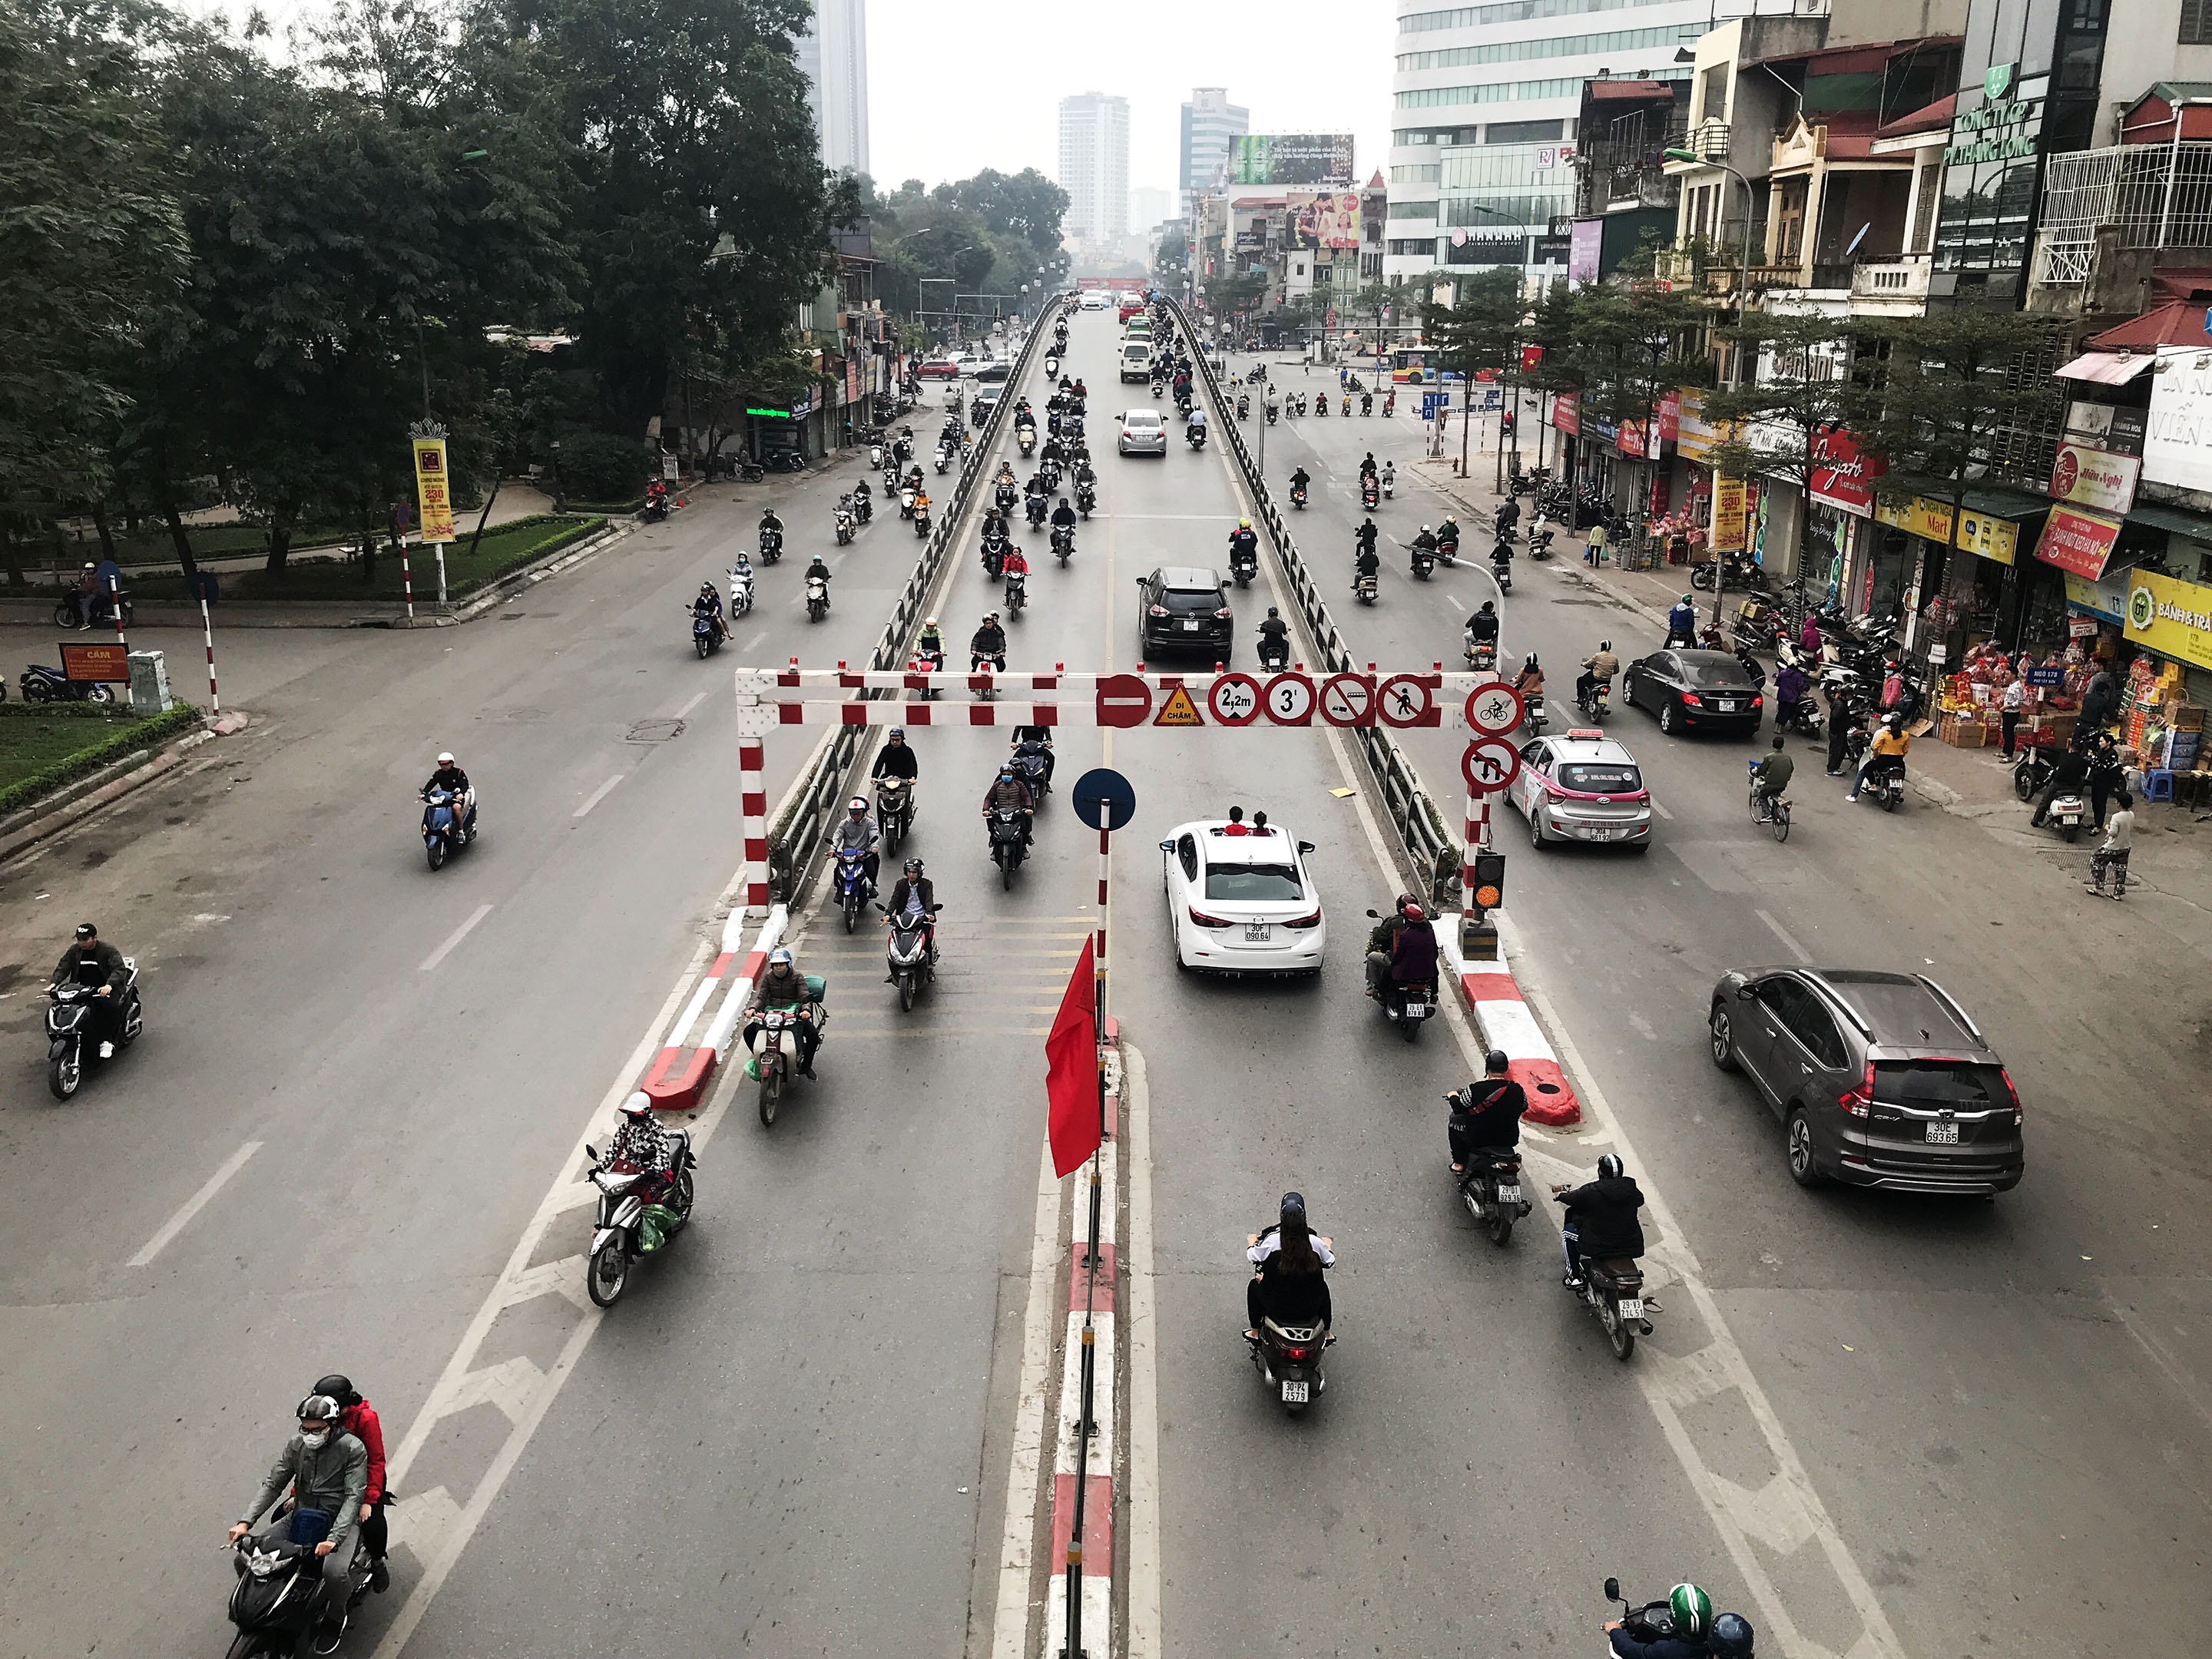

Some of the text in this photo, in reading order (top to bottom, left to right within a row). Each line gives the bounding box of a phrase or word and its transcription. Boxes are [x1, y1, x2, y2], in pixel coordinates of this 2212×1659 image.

[425, 489, 444, 499] 230
[1721, 496, 1740, 507] 230
[1927, 515, 1948, 536] Mart
[1221, 688, 1251, 710] 2,2m
[1167, 711, 1191, 720] CHẬM
[1935, 1122, 1951, 1132] 30E
[1926, 1132, 1958, 1144] 693.65
[1285, 1392, 1306, 1401] 2579
